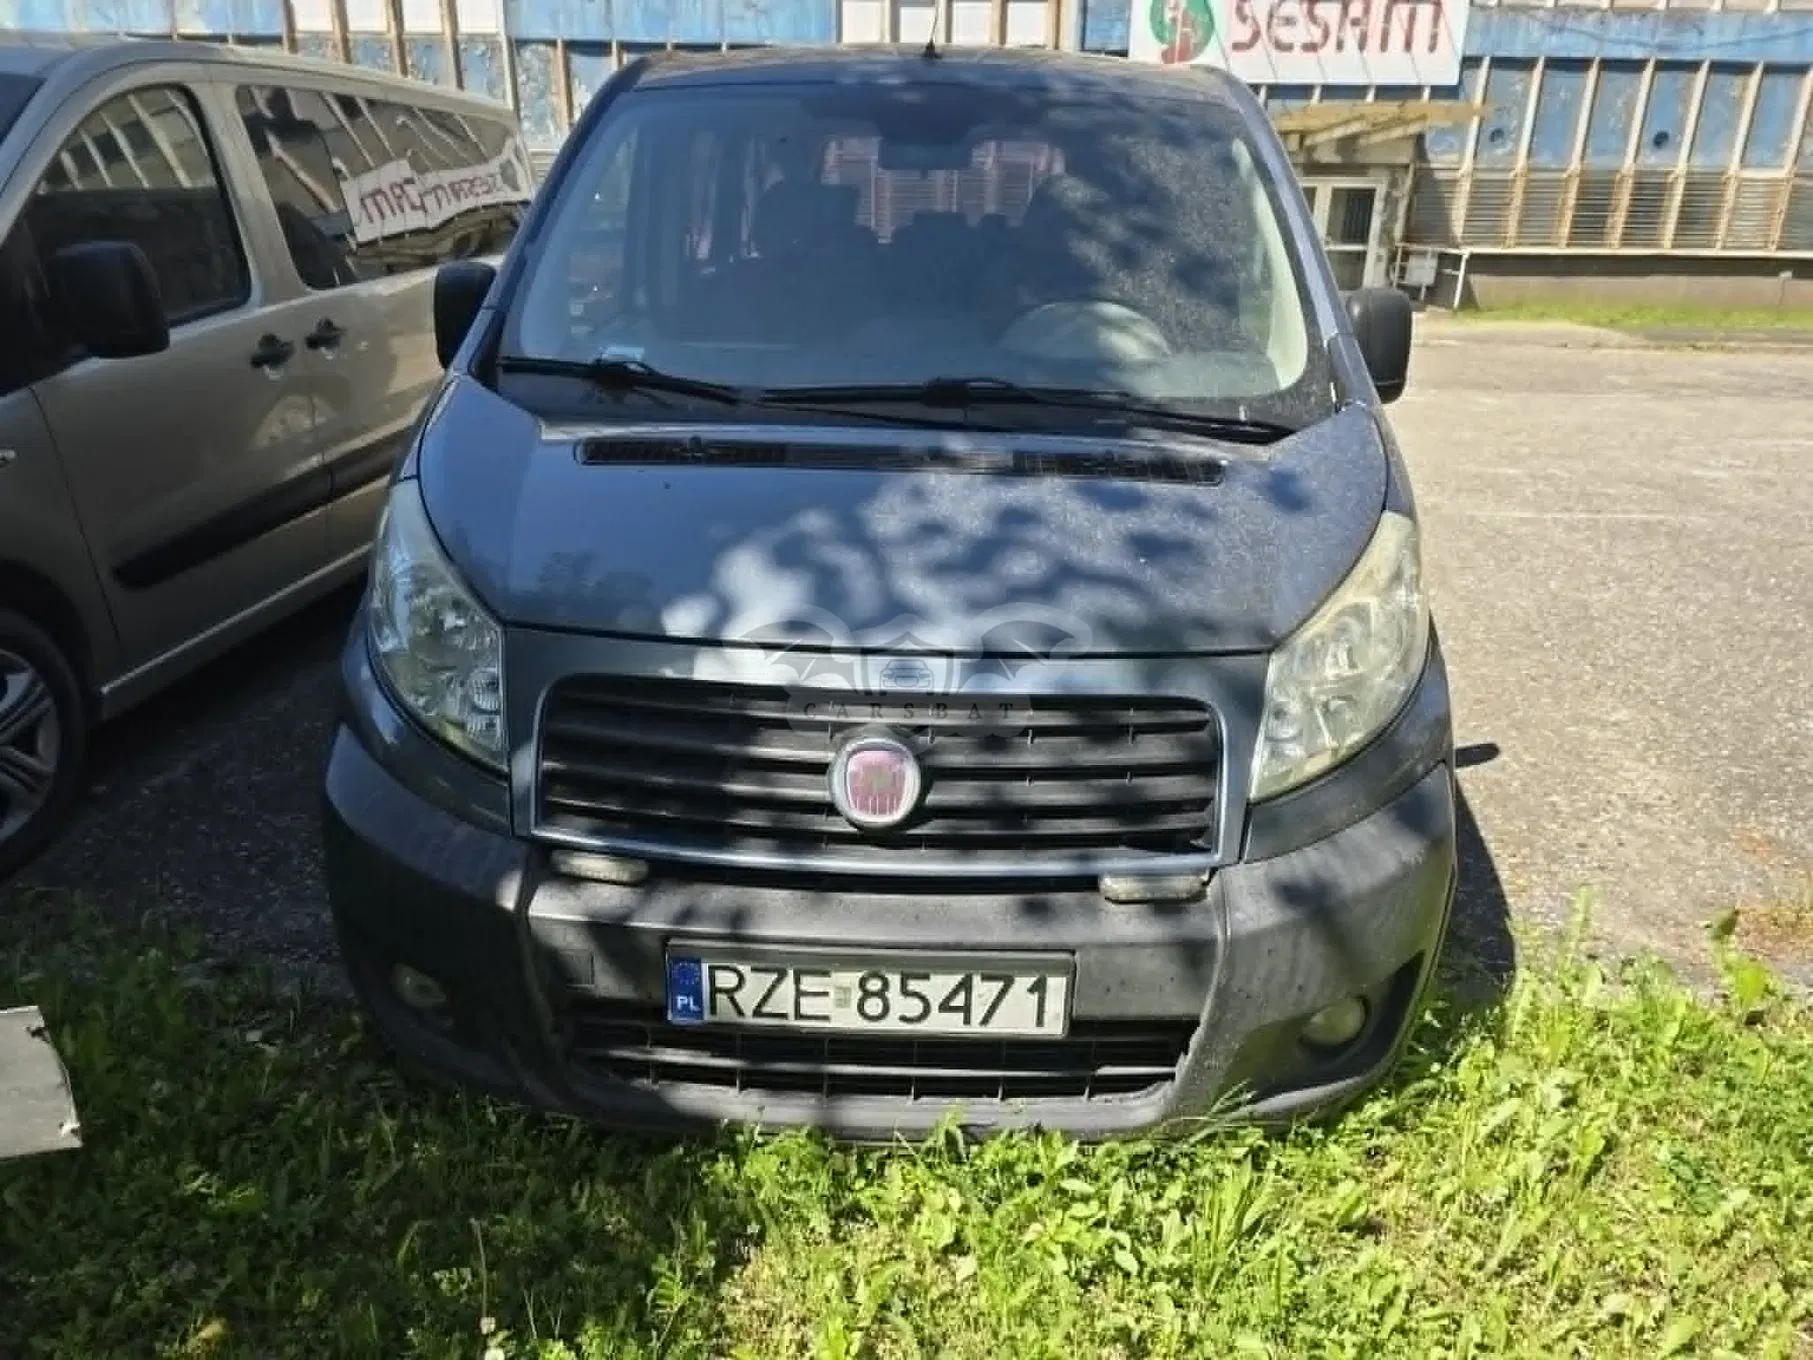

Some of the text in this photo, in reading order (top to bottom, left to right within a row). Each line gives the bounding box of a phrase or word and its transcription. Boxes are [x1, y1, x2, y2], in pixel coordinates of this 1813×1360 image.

[676, 995, 701, 1011] PL
[708, 964, 1049, 1028] RZE 85471
